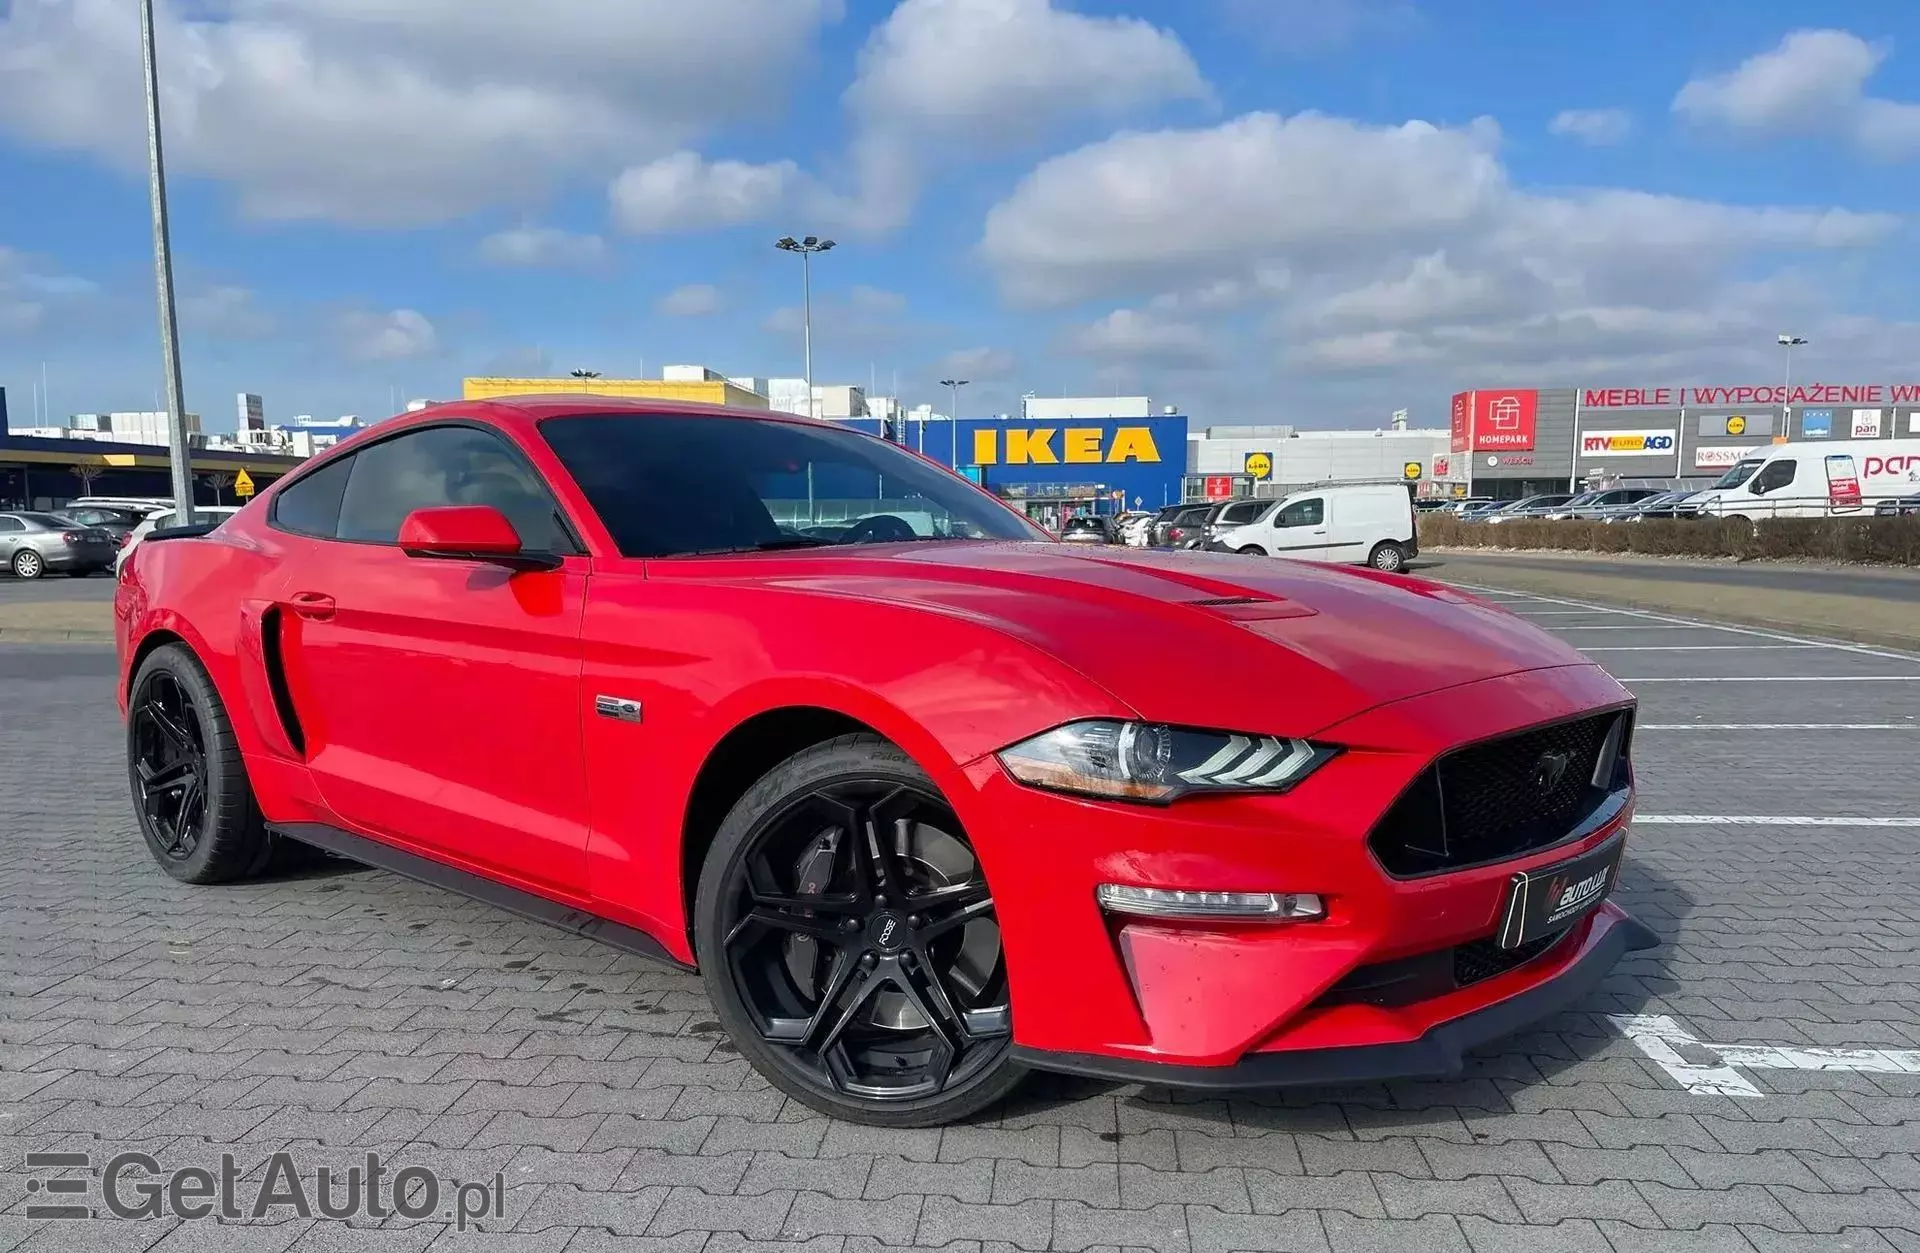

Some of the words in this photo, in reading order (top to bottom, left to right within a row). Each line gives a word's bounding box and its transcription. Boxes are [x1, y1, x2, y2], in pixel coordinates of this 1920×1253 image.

[1584, 388, 1671, 407] MEBLE
[1693, 383, 1883, 404] WYPOSAŻENIE
[1855, 424, 1877, 436] pan
[973, 427, 1162, 465] IKEA
[1479, 434, 1528, 444] HOMEPARK
[1584, 437, 1612, 451] RTV
[1643, 436, 1673, 450] AGD
